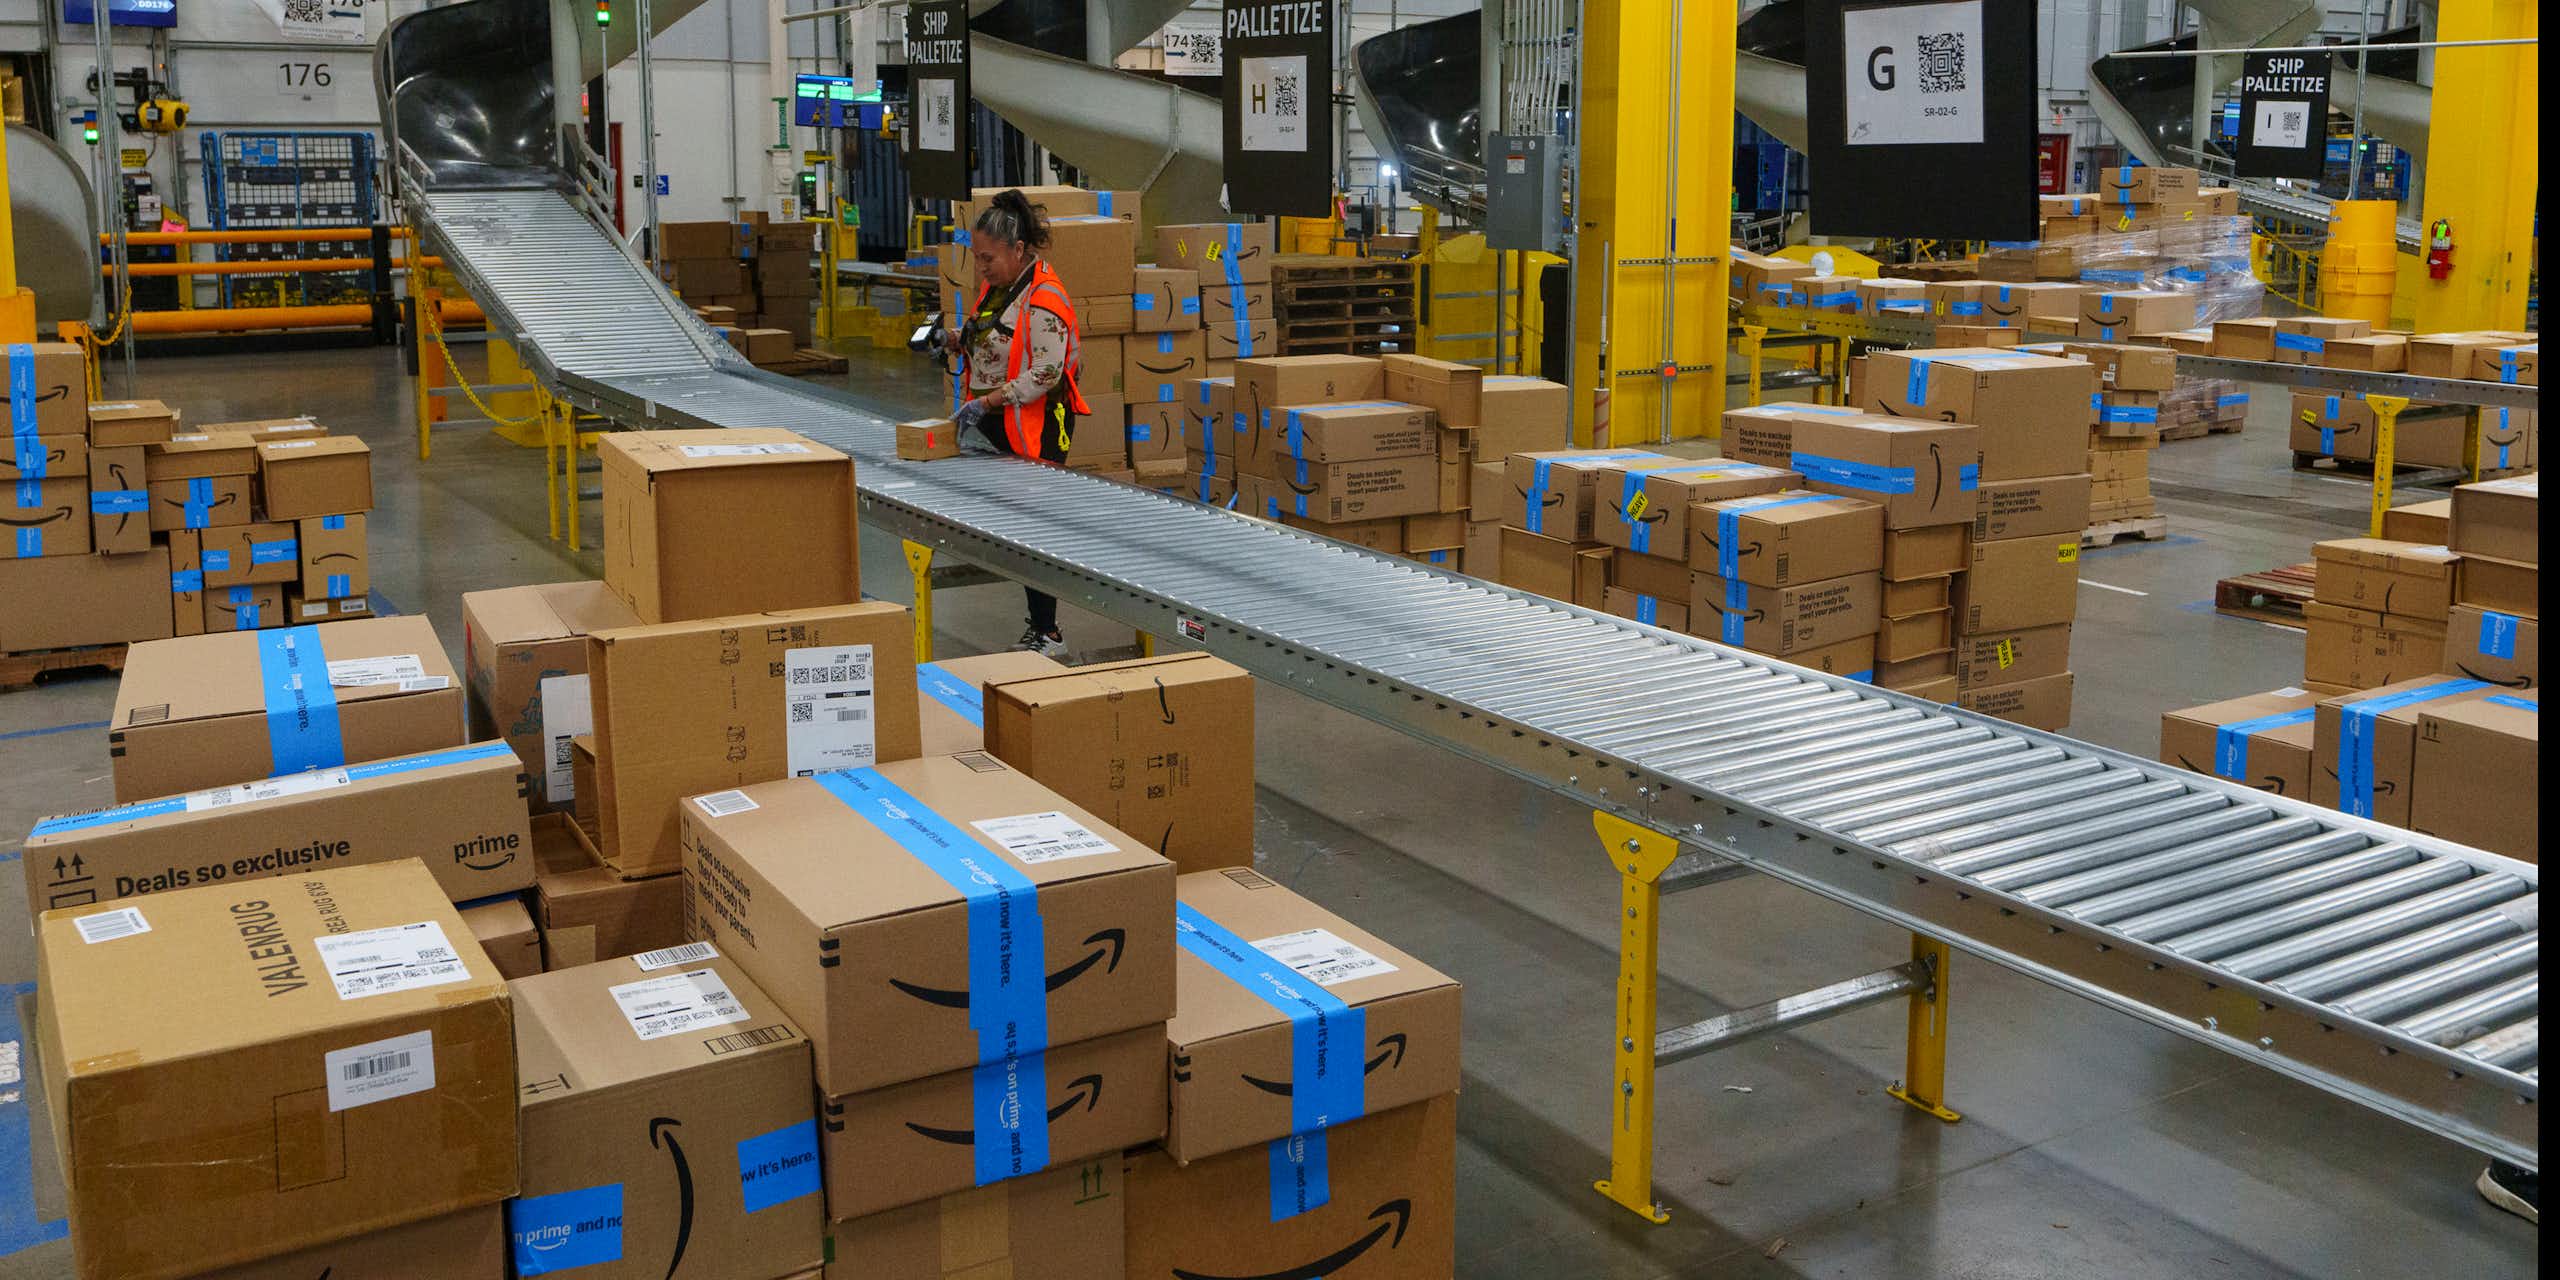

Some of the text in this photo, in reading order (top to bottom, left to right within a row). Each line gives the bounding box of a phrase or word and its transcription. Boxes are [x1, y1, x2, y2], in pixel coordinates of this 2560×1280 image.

[923, 11, 948, 35] SHIP
[1227, 1, 1322, 39] PALLETIZE
[910, 39, 963, 64] PALLETIZE
[1165, 34, 1189, 48] 174
[279, 63, 332, 87] 176
[1867, 46, 1895, 91] G
[2267, 58, 2304, 74] SHIP
[2245, 76, 2325, 92] PALLETIZE
[1252, 83, 1266, 114] H
[1924, 106, 1957, 117] SR-02-G
[1347, 472, 1364, 480] Deals
[1374, 469, 1402, 477] exclusive
[1347, 487, 1364, 495] meet
[1993, 492, 2008, 500] Deals
[2016, 488, 2040, 497] exclusive
[1630, 494, 1646, 518] HEAVY
[2058, 549, 2075, 558] HEAVY
[1800, 592, 1815, 601] Deals
[1824, 586, 1850, 596] exclusive
[1820, 597, 1837, 607] ready
[1799, 611, 1814, 620] meet
[1815, 610, 1828, 618] your
[455, 831, 519, 864] prime
[116, 838, 351, 898] Deals so exclusive
[697, 836, 752, 902] Deals so exclusive
[698, 857, 746, 919] they're ready to
[314, 896, 340, 917] RUG
[699, 881, 758, 951] meet your parents.
[1000, 902, 1011, 930] now
[230, 900, 308, 997] VALENRUG
[1000, 930, 1012, 952] it's
[1000, 953, 1012, 989] here.
[1317, 1028, 1329, 1048] it's
[1317, 1049, 1329, 1080] here.
[1008, 1071, 1017, 1089] on
[1006, 1092, 1022, 1129] prime
[1011, 1132, 1024, 1156] and
[758, 1161, 780, 1177] it's
[781, 1152, 816, 1172] here.
[1012, 1157, 1022, 1174] no
[1296, 1166, 1306, 1188] and
[526, 1223, 572, 1246] prime
[575, 1216, 605, 1234] and
